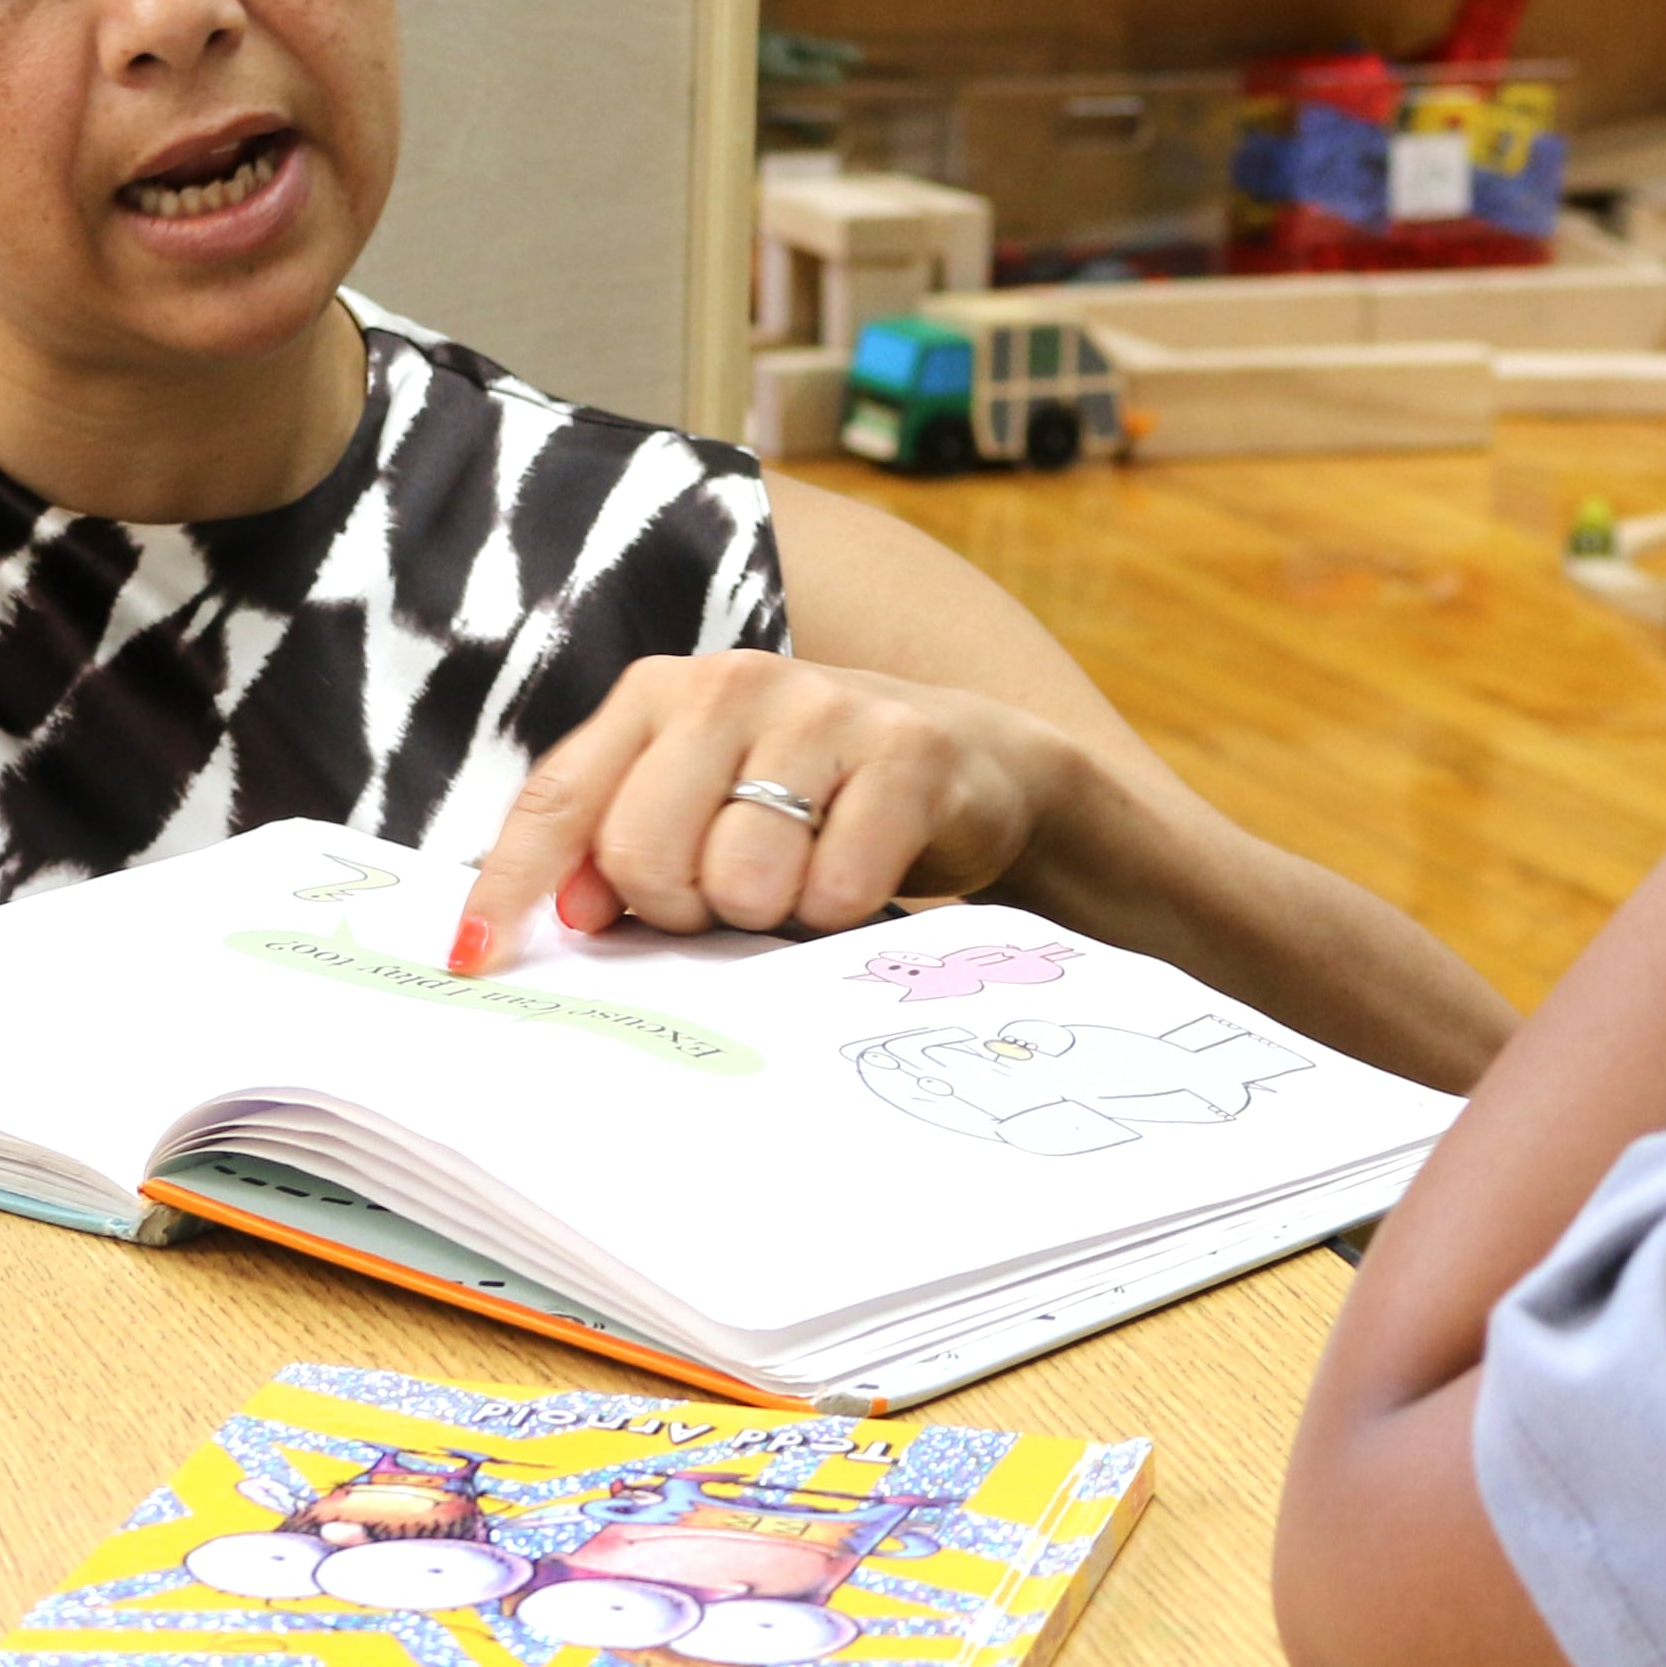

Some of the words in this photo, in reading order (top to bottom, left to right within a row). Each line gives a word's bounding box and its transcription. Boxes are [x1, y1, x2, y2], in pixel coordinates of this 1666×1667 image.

[264, 940, 355, 967] too?
[357, 965, 458, 990] play
[443, 987, 476, 997] I
[481, 990, 561, 1012] Can
[567, 1009, 726, 1058] Excuse
[471, 1402, 714, 1445] Arnold
[732, 1428, 899, 1465] Tedd
